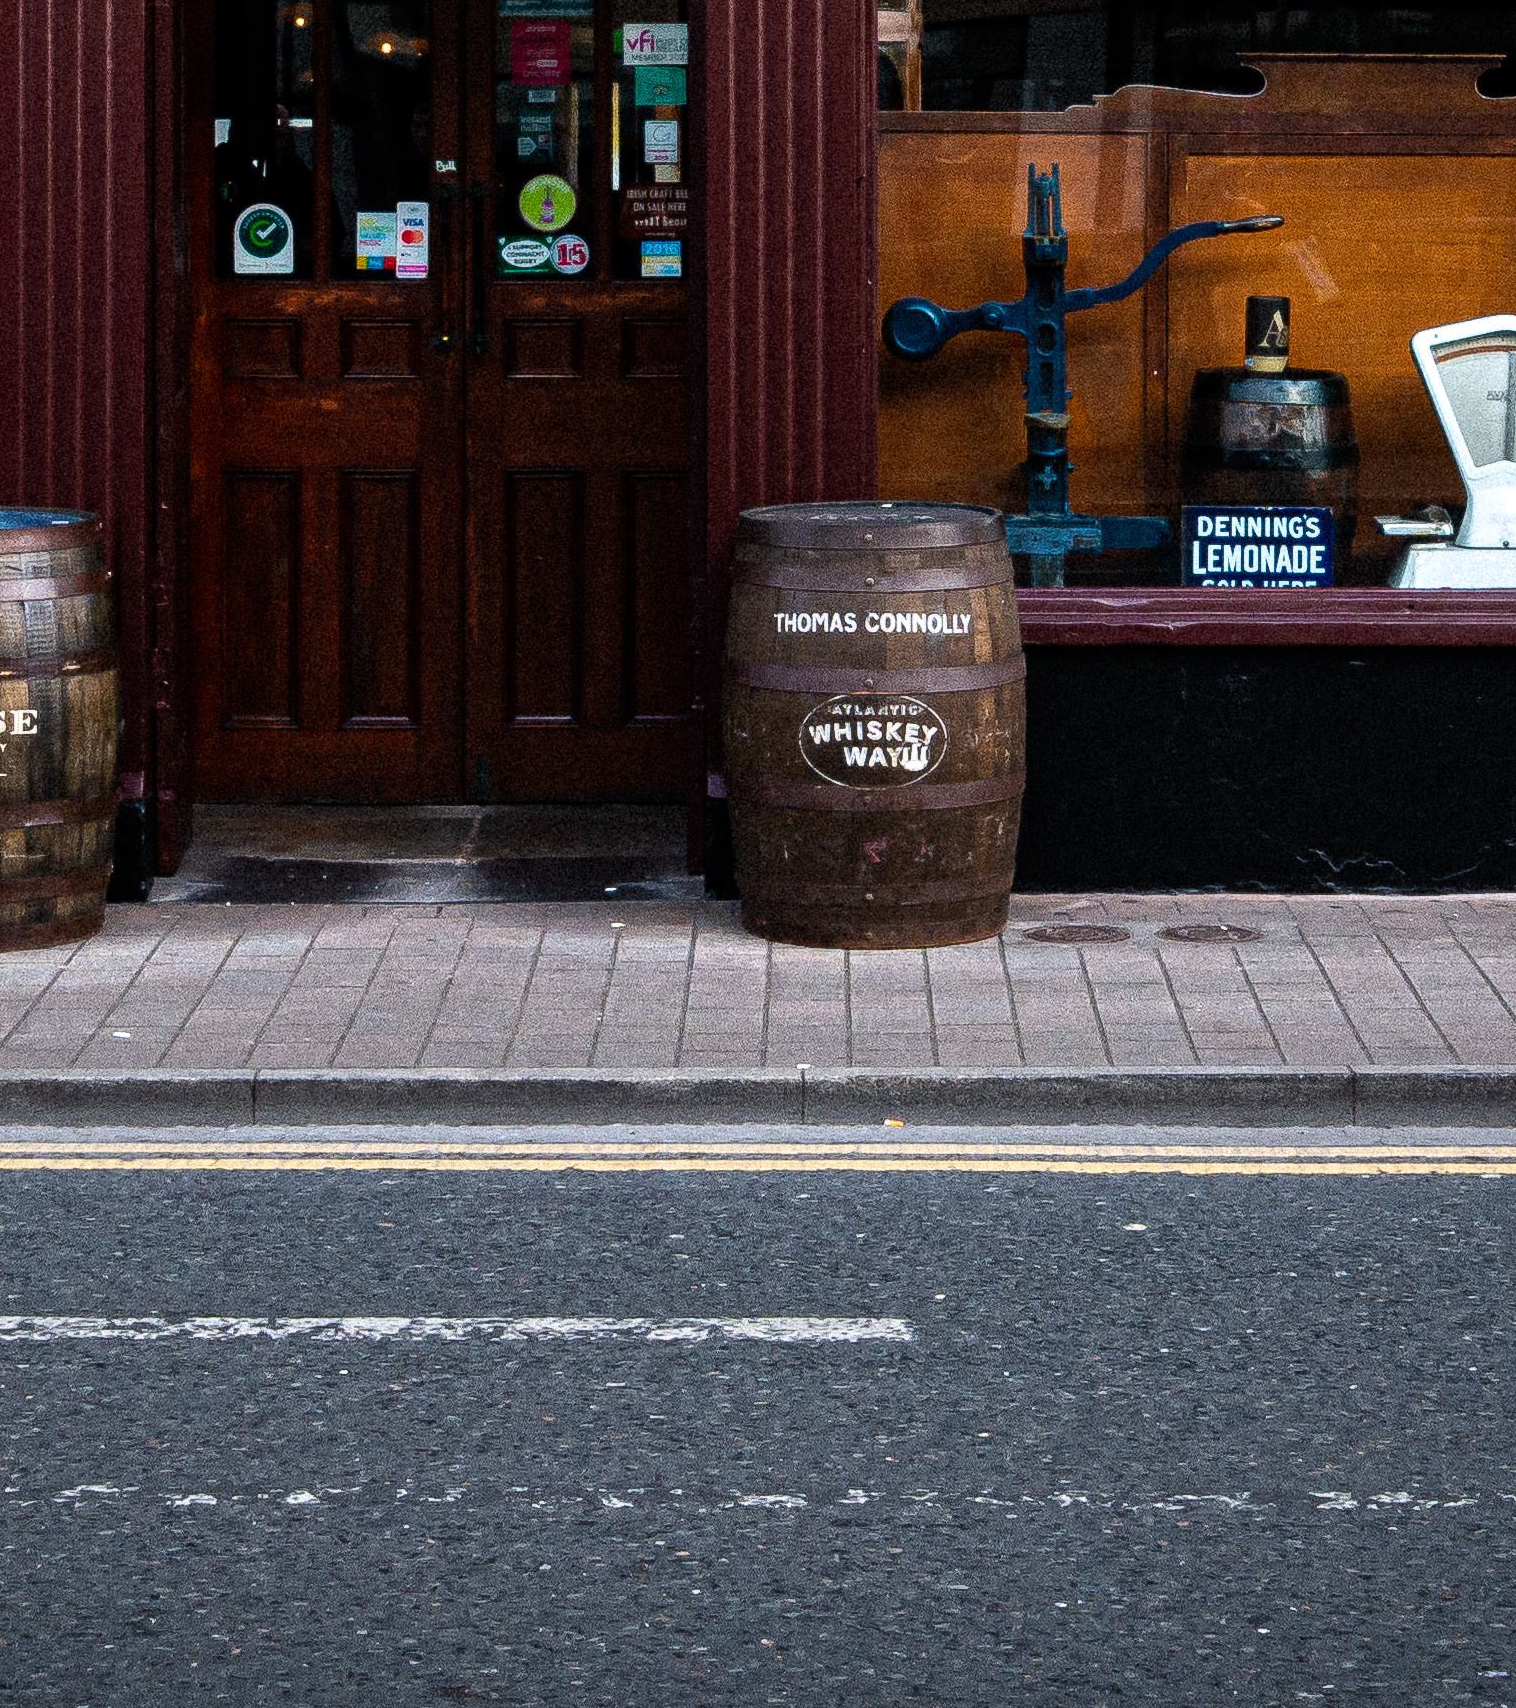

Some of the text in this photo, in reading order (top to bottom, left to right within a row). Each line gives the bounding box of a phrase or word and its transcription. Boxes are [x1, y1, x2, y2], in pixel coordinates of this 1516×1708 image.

[435, 160, 457, 172] Pull
[647, 202, 666, 212] SALE
[403, 218, 424, 226] VISA
[1197, 514, 1321, 539] DENNING'S
[1192, 540, 1326, 575] LEMONADE
[774, 612, 971, 634] THOMAS CONNOLLY
[808, 721, 938, 745] WHISKEY
[843, 746, 905, 767] WAY
